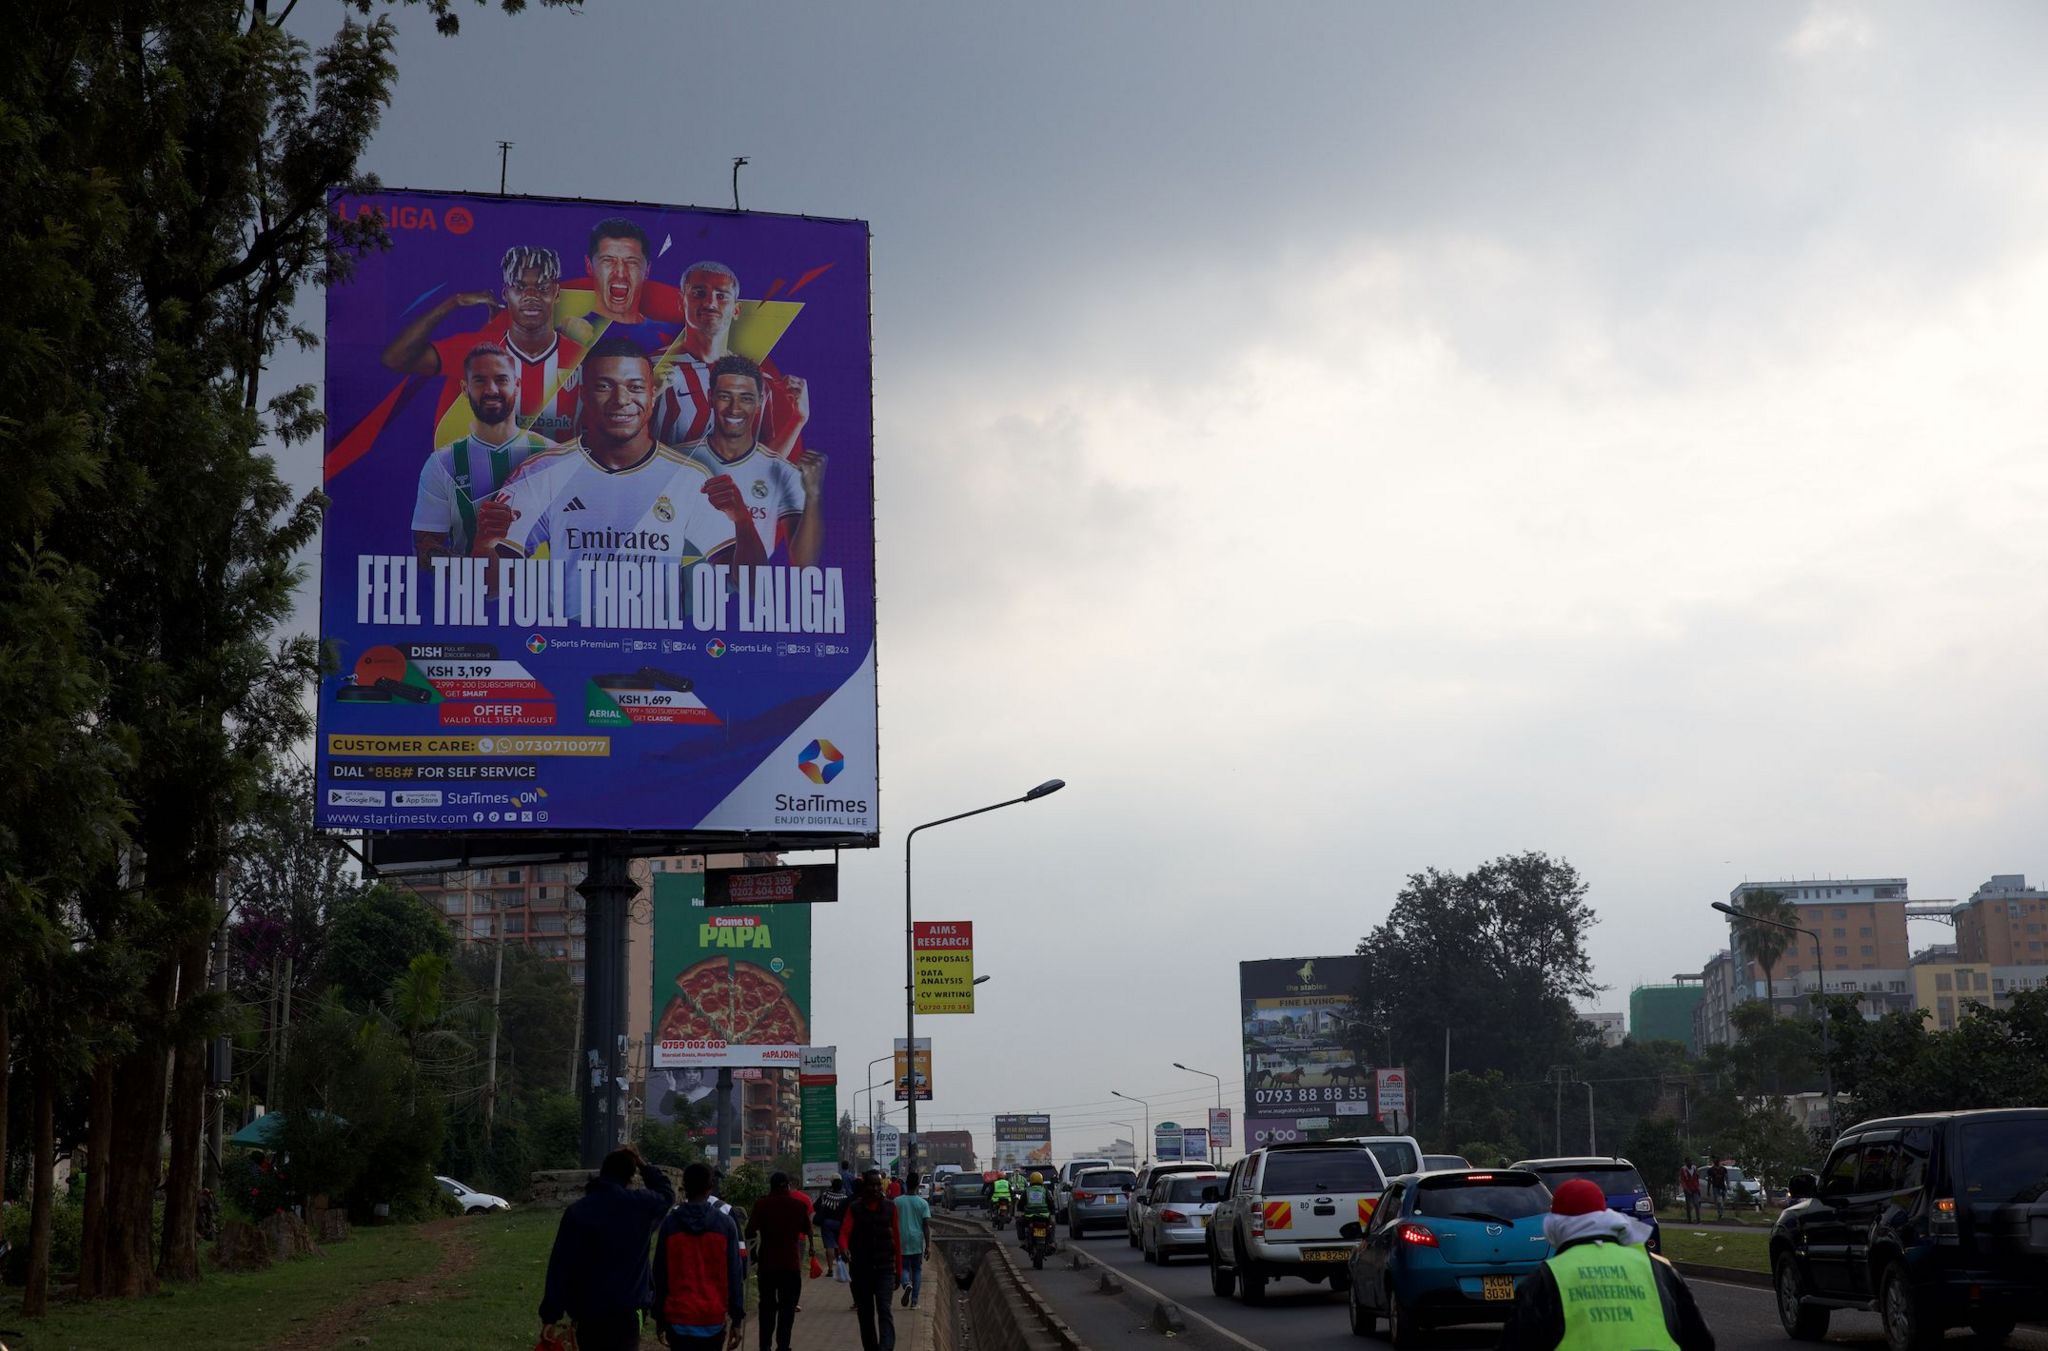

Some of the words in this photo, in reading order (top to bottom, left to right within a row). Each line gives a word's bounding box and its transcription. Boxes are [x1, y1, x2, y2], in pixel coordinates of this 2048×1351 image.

[566, 527, 669, 551] Emirates
[358, 555, 421, 625] FEEL
[431, 557, 489, 626] THE
[498, 558, 568, 627] FULL
[578, 560, 684, 630] THRILL
[693, 563, 731, 632] OF
[739, 565, 846, 634] LALIGA
[550, 639, 579, 652] Sports
[580, 640, 620, 650] Premium
[729, 643, 756, 654] Sports
[757, 644, 773, 653] Life
[411, 647, 443, 658] DISH
[427, 666, 454, 678] KSH
[458, 667, 493, 679] 3,199
[445, 690, 461, 698] GET
[462, 690, 489, 698] SMART
[618, 695, 641, 704] KSH
[643, 696, 672, 707] 1,699
[473, 705, 523, 717] OFFER
[589, 709, 621, 718] AERIAL
[443, 716, 471, 724] VALID
[473, 716, 493, 724] TILL
[495, 716, 515, 724] 31ST
[516, 717, 554, 725] AUGUST
[333, 739, 423, 752] CUSTOMER
[427, 741, 476, 753] CARE:
[515, 741, 607, 753] 0730710077
[334, 765, 365, 777] DIAL
[417, 767, 444, 778] FOR
[447, 767, 478, 778] SELF
[480, 767, 537, 778] SERVICE
[345, 795, 368, 805] Google
[369, 796, 382, 805] Play
[406, 796, 420, 805] App
[421, 796, 439, 804] Store
[447, 791, 509, 804] StarTimes
[519, 791, 538, 803] ON
[775, 793, 868, 813] StarTimes
[326, 812, 469, 825] www.startimestv.com
[774, 816, 806, 825] ENJOY
[807, 817, 844, 825] DIGITAL
[847, 818, 869, 826] LIFE
[774, 885, 794, 895] 005
[715, 917, 744, 926] Come
[744, 917, 755, 926] to
[699, 923, 772, 948] PAPA
[929, 926, 957, 935] AIMS
[917, 937, 970, 947] RESEARCH
[919, 955, 971, 963] PROPOSALS
[1299, 983, 1327, 992] stables
[1279, 999, 1301, 1007] FINE
[1303, 997, 1335, 1005] LIVING
[687, 1040, 706, 1050] 002
[707, 1040, 727, 1050] 003
[1255, 1089, 1292, 1103] 0793
[1298, 1088, 1317, 1101] 88
[1323, 1087, 1342, 1100] 88
[1349, 1087, 1367, 1099] 55
[1577, 1265, 1629, 1280] KEMUMA
[1568, 1285, 1646, 1302] ENGINEERING
[1589, 1306, 1635, 1322] SYSTEM
